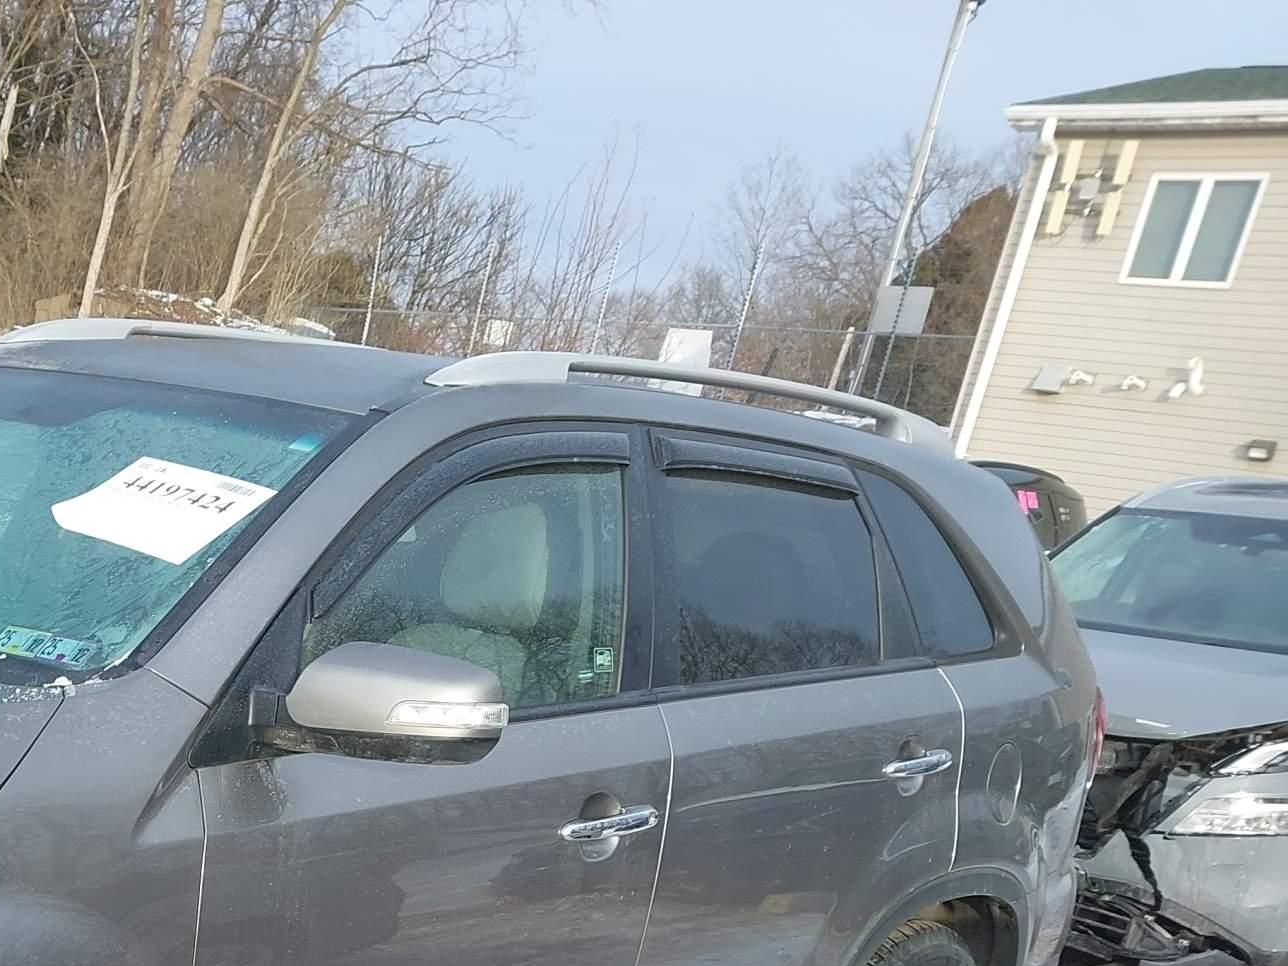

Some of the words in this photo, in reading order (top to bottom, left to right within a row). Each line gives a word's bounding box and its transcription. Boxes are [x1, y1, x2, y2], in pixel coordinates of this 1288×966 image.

[122, 476, 236, 514] 44197424
[41, 638, 64, 656] 25
[71, 647, 90, 663] 12
